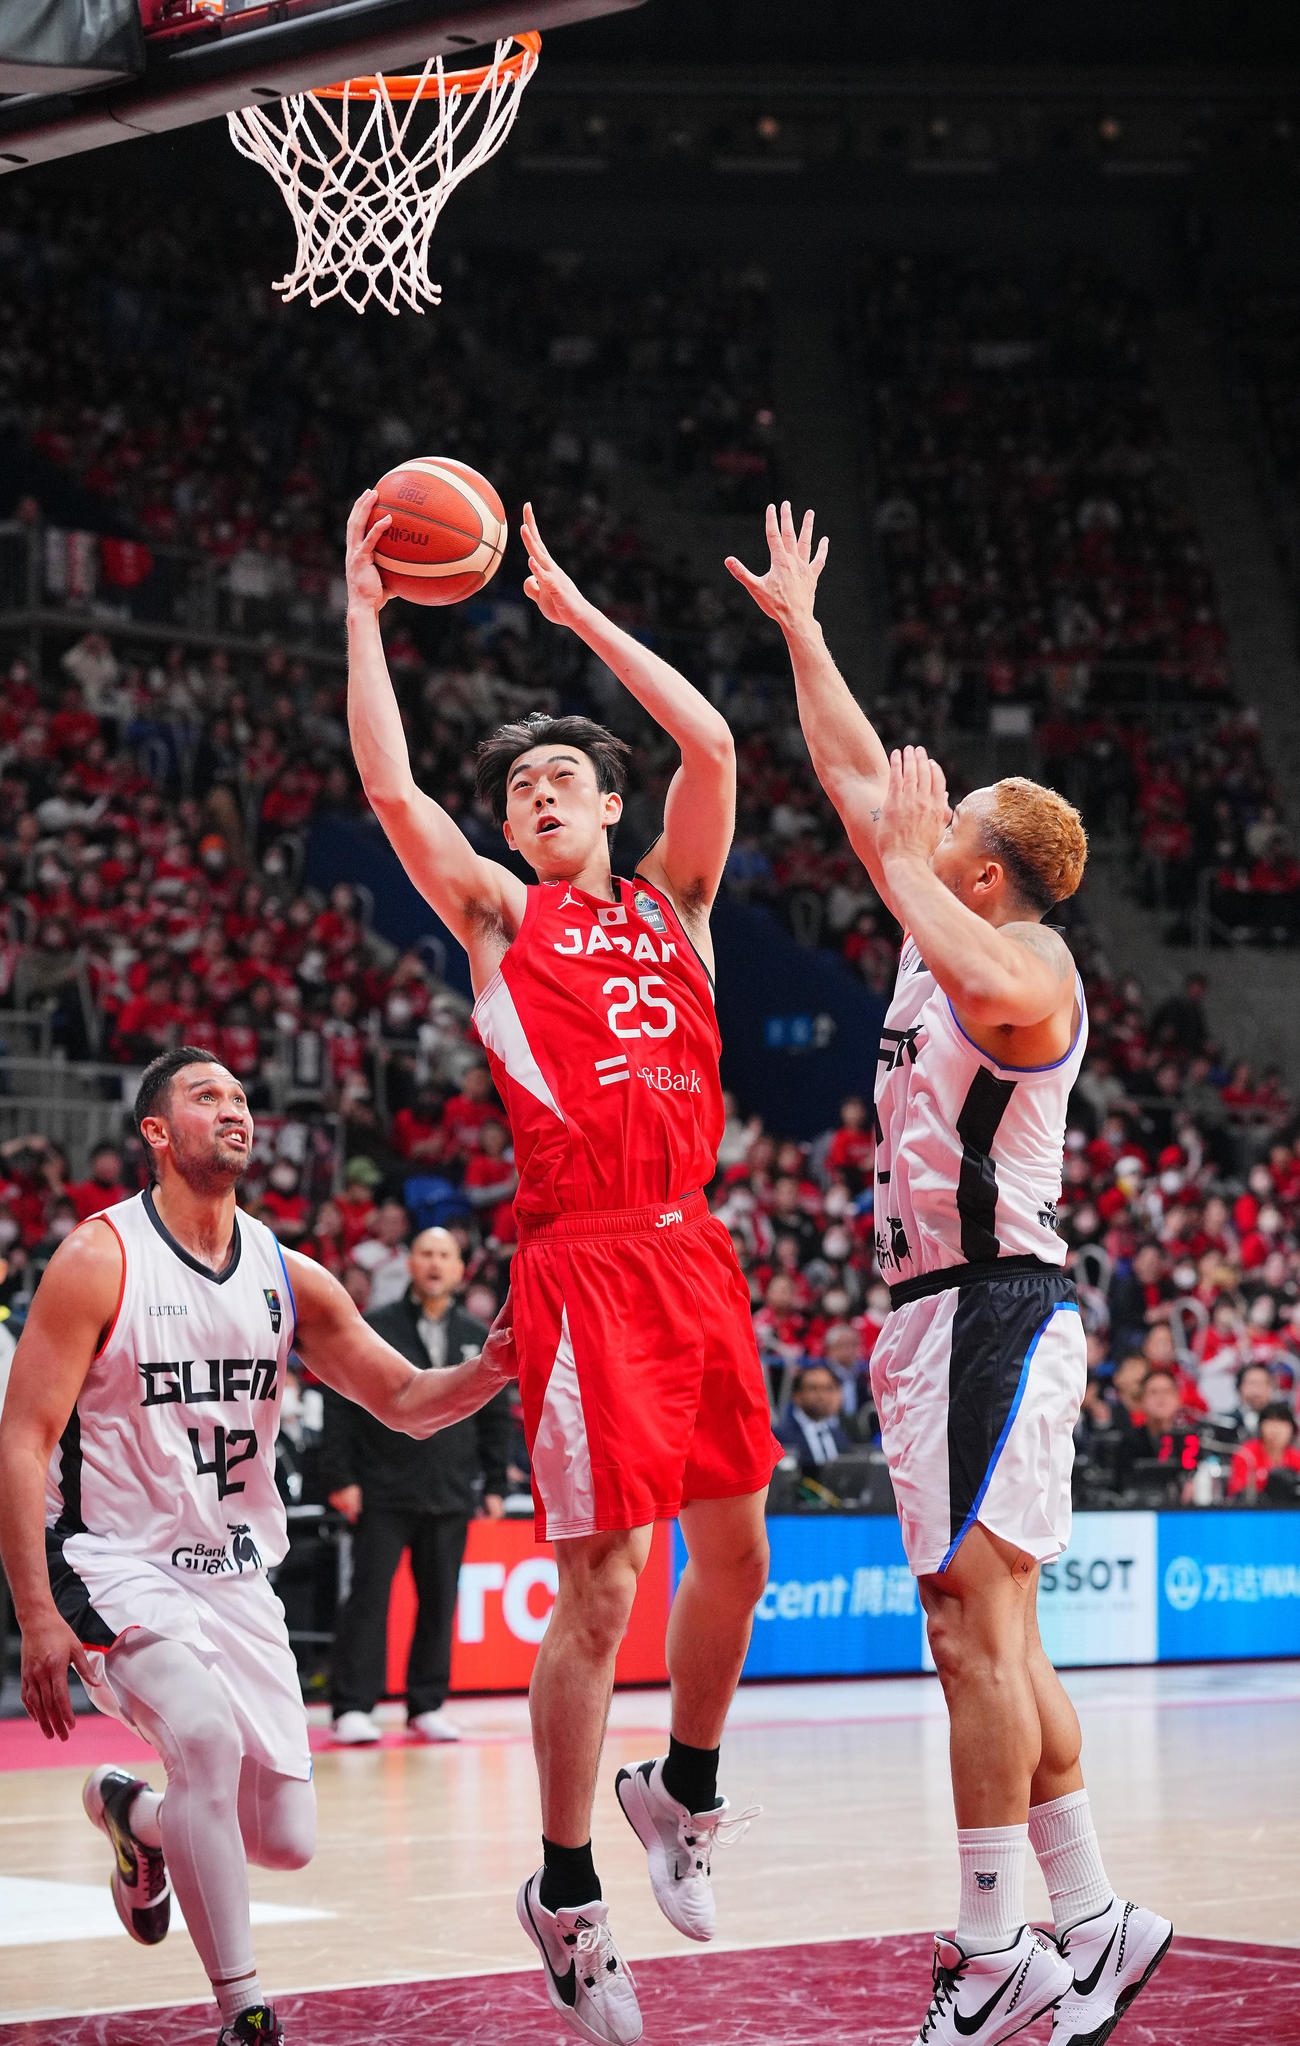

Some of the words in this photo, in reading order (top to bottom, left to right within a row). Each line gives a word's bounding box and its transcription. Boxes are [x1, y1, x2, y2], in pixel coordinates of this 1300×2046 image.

[602, 975, 677, 1039] 25
[655, 1209, 683, 1228] JPN
[148, 1304, 188, 1317] CUTCH
[187, 1425, 259, 1502] 42
[194, 1543, 227, 1559] Bank
[1040, 1559, 1135, 1593] SSOT
[458, 1558, 558, 1644] TC
[755, 1574, 848, 1621] cent
